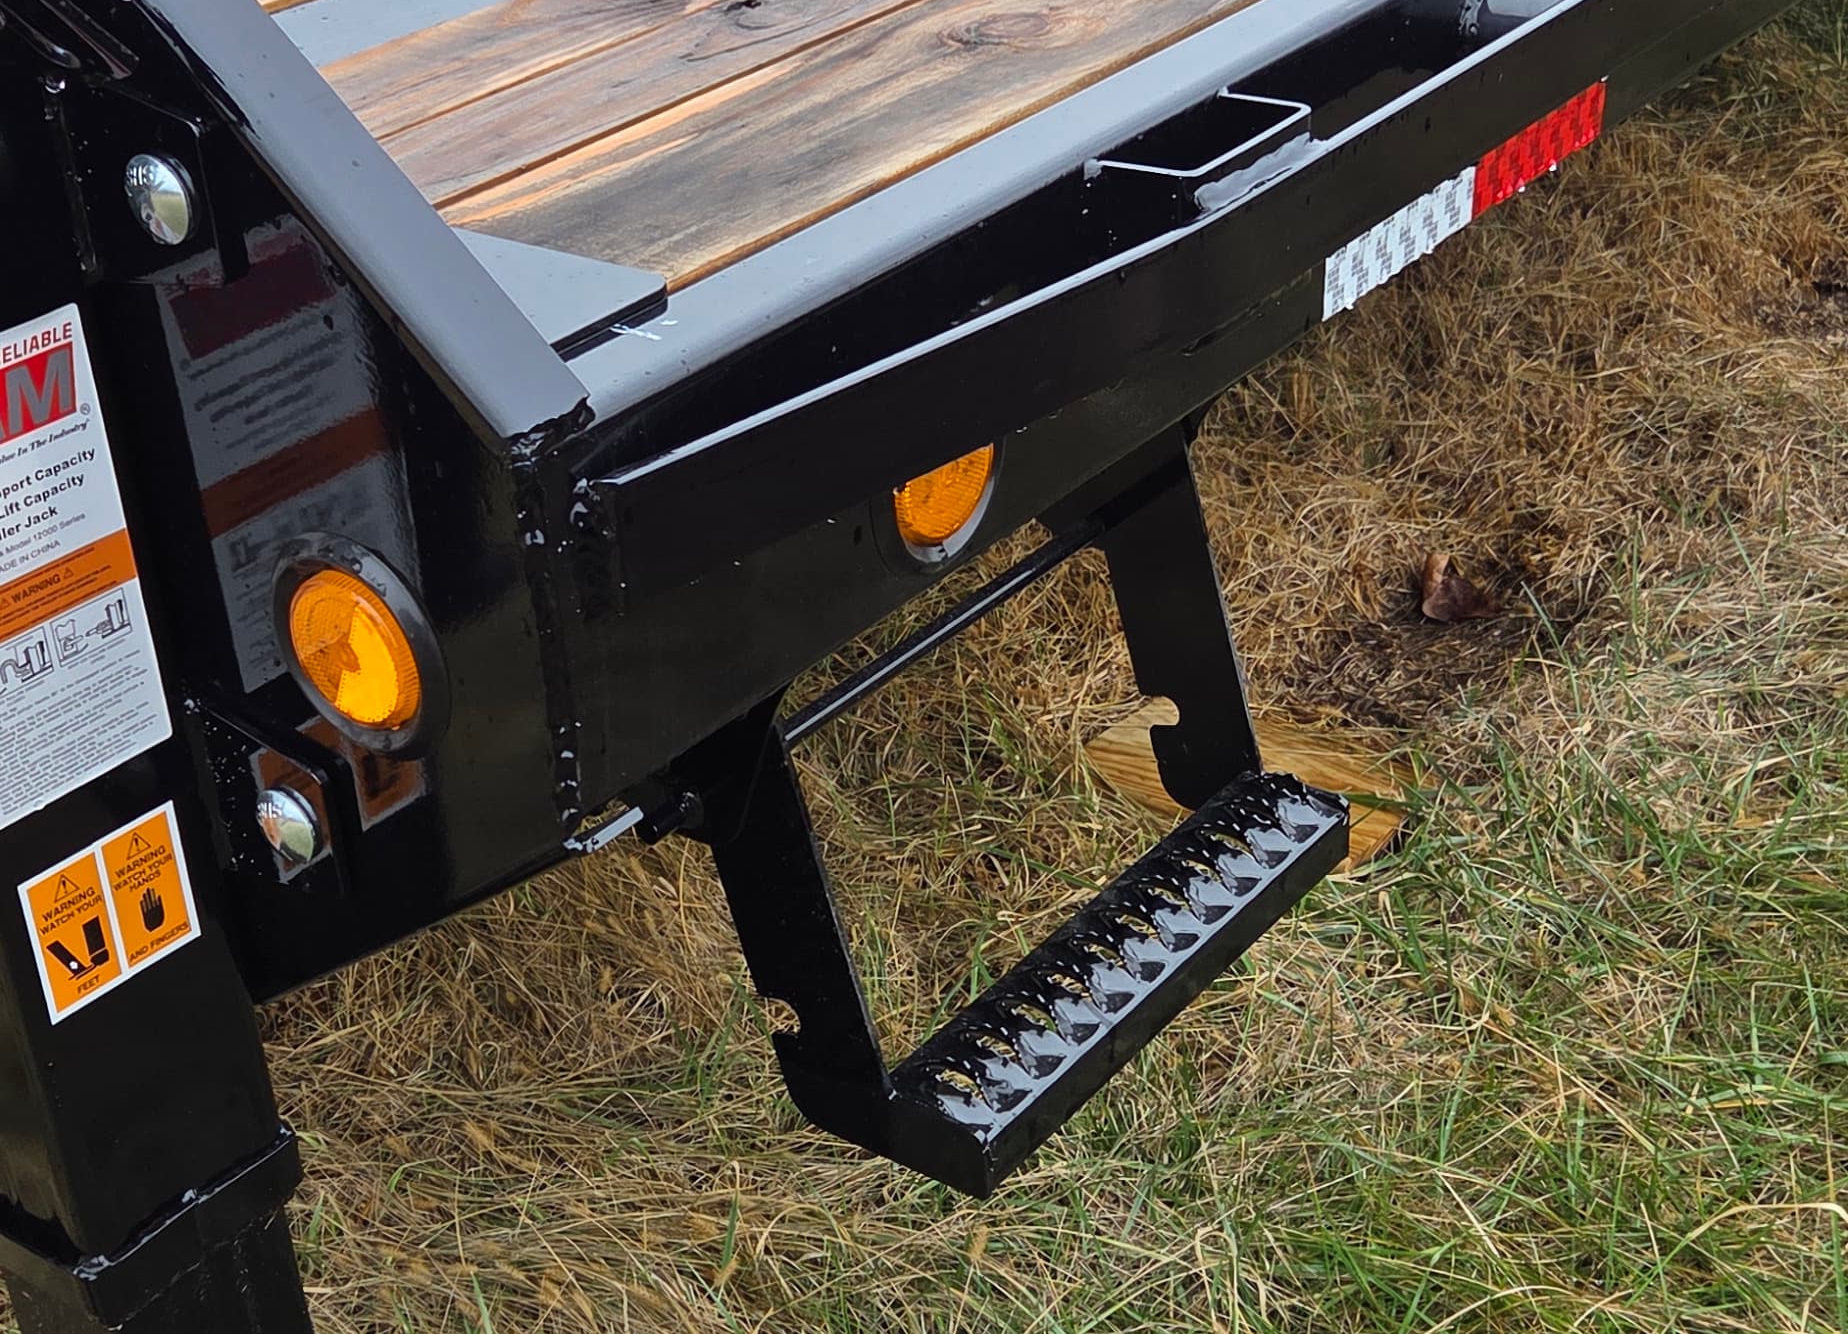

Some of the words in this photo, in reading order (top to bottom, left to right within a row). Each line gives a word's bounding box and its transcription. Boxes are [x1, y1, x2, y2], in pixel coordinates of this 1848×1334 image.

[0, 322, 72, 365] ELIABLE
[0, 475, 32, 499] port
[35, 448, 95, 481] Capacity
[23, 474, 84, 508] Capacity
[24, 506, 58, 528] Jack
[31, 540, 61, 558] CHINA
[11, 573, 61, 603] WARNING
[113, 869, 147, 892] WATCH
[148, 853, 173, 873] YOUR
[115, 845, 166, 879] WARNING
[129, 870, 162, 893] HANDS
[39, 913, 75, 936] WATCH
[76, 895, 103, 915] YOUR
[42, 886, 96, 922] WARNING
[129, 945, 150, 963] AND
[150, 922, 189, 950] FINGERS
[77, 974, 101, 994] FEET
